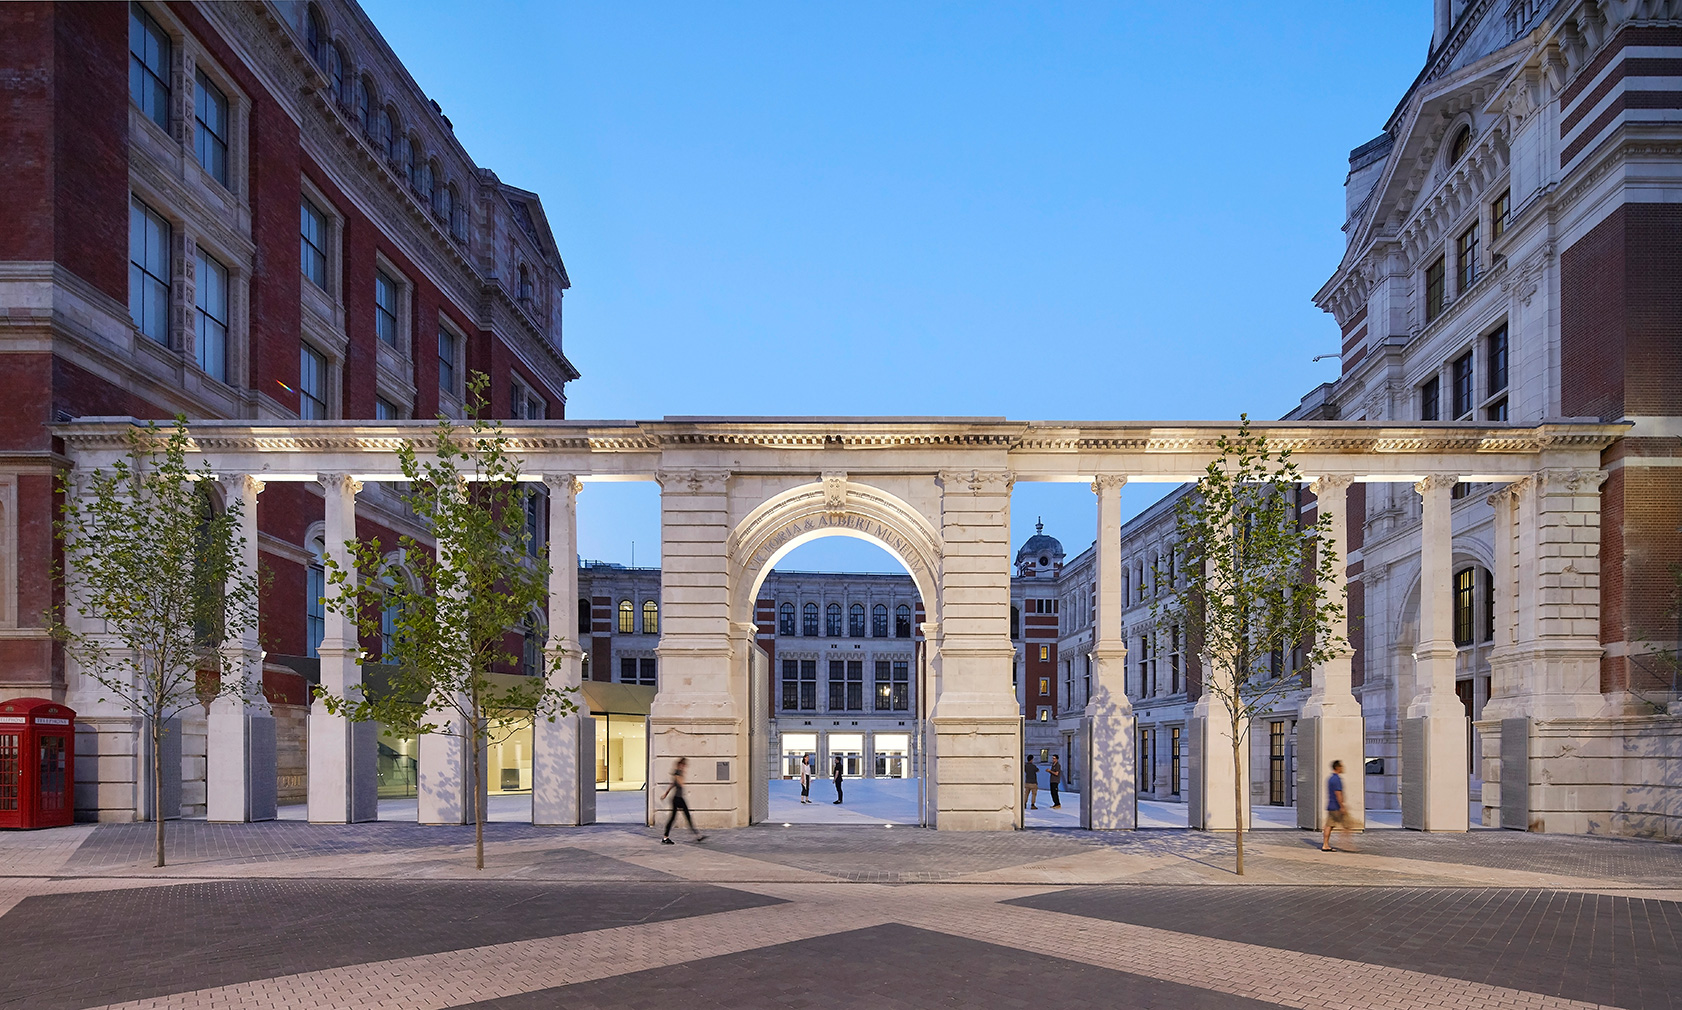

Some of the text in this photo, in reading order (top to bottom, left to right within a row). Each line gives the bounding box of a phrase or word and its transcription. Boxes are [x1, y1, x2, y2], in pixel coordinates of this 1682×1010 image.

[747, 514, 925, 575] VICTORIA & ALBERT MUSEUM
